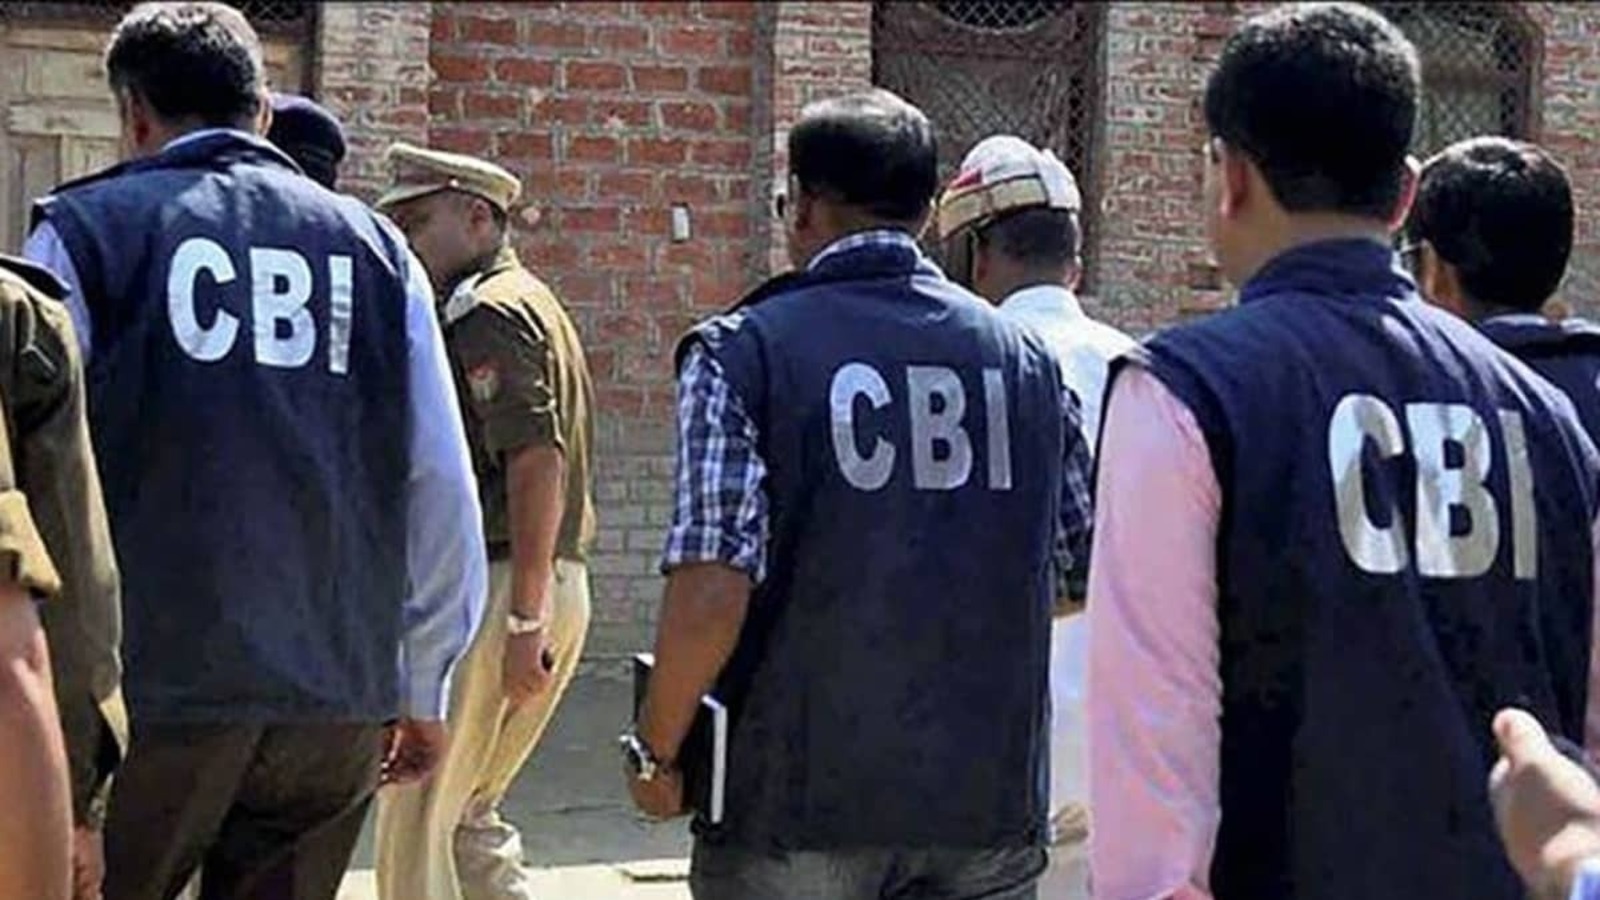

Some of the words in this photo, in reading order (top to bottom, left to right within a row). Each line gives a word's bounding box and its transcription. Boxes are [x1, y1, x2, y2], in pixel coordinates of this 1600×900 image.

[166, 237, 353, 374] CBI
[829, 362, 1013, 491] CBI
[1328, 394, 1537, 580] CBI
